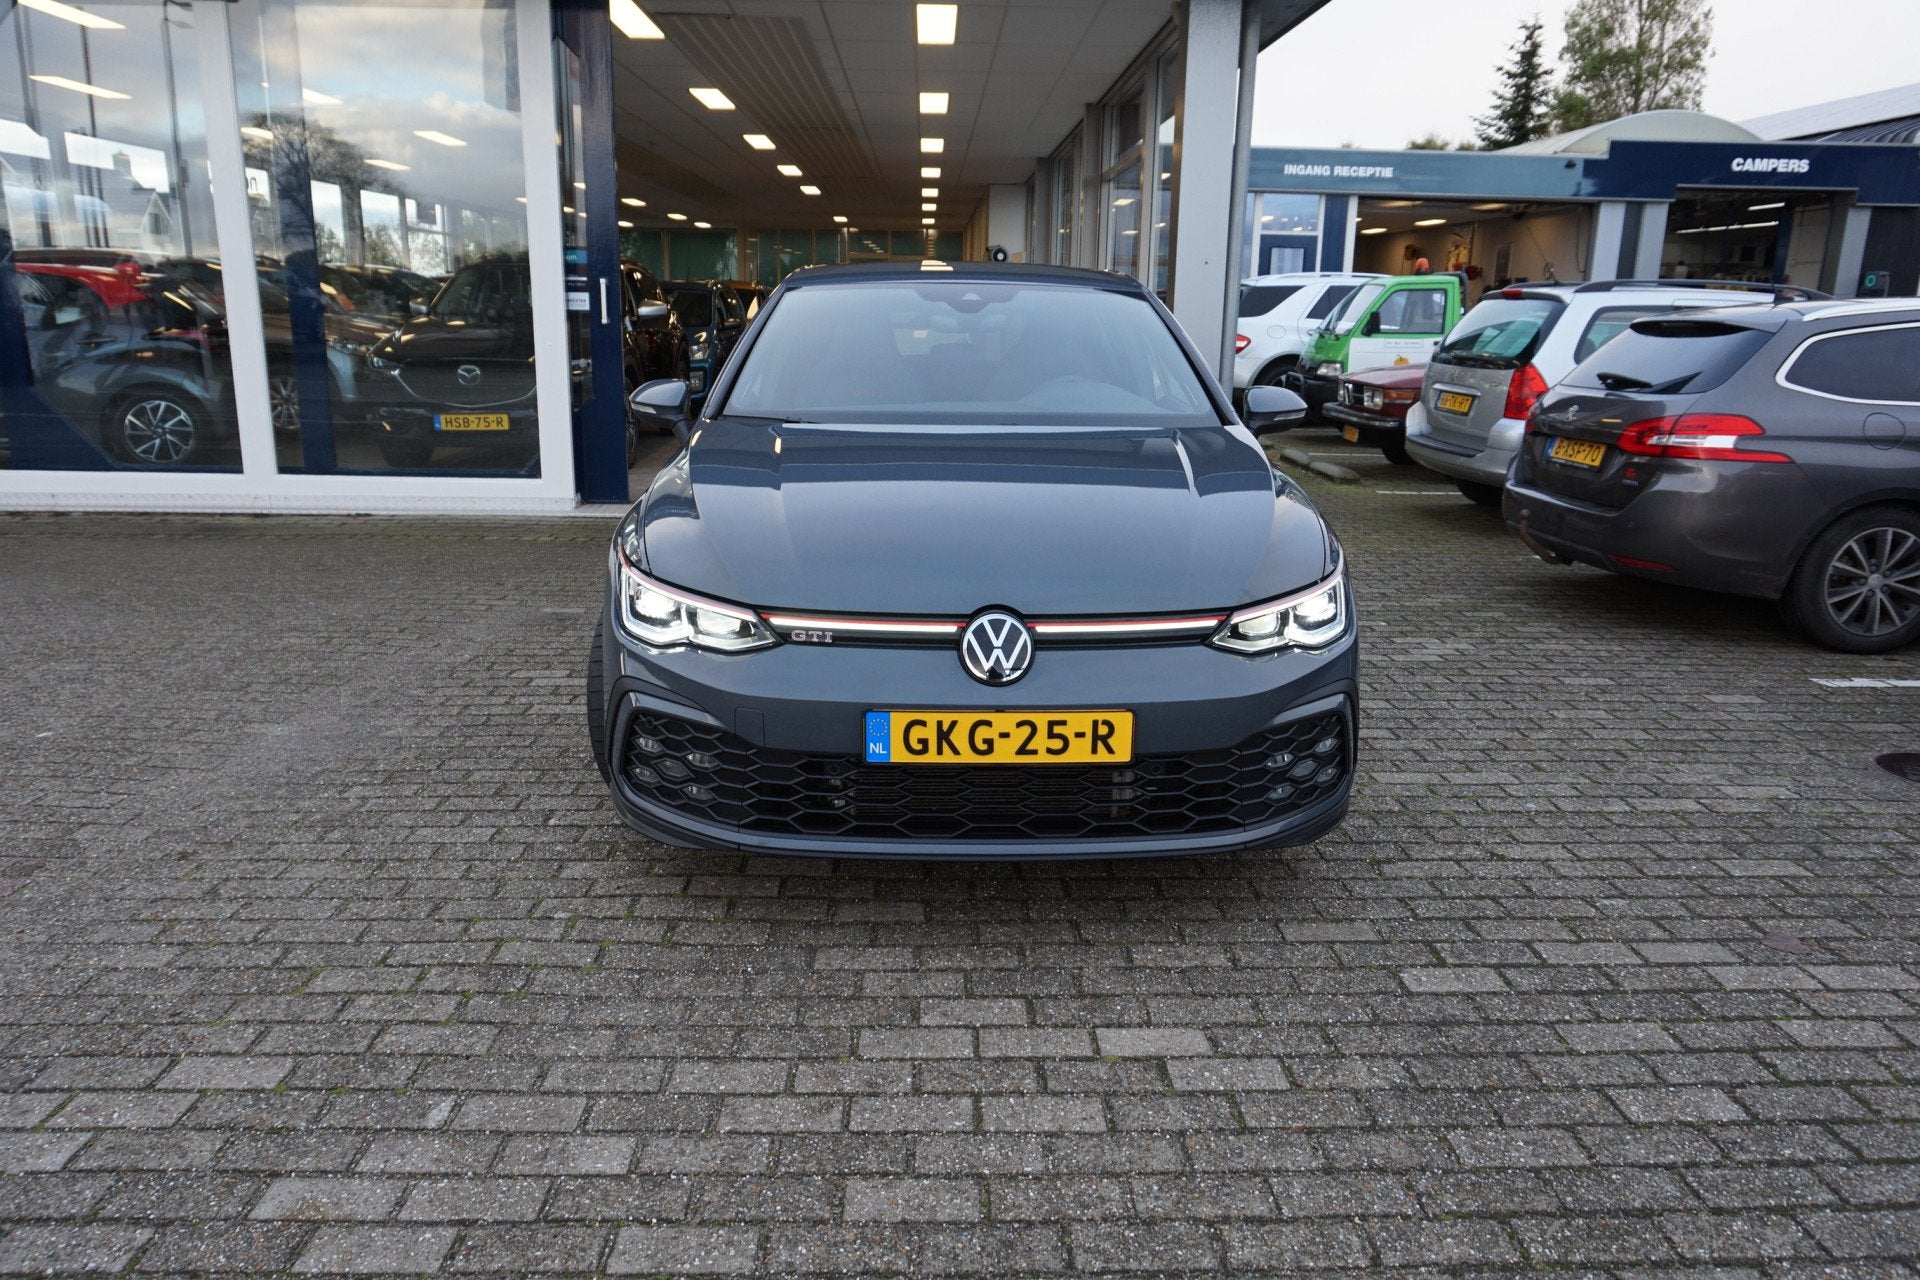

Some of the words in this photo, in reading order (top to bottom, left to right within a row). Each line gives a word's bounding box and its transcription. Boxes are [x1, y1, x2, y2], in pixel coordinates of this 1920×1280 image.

[1284, 164, 1331, 176] INGANG
[1333, 165, 1394, 178] RECEPTIE
[1731, 157, 1810, 173] CAMPERS
[444, 416, 504, 428] HSB-75-R
[1555, 440, 1602, 463] 8-XSF-70
[791, 629, 833, 643] GTI
[869, 742, 887, 754] NL
[902, 718, 1116, 756] GKG-25-R
